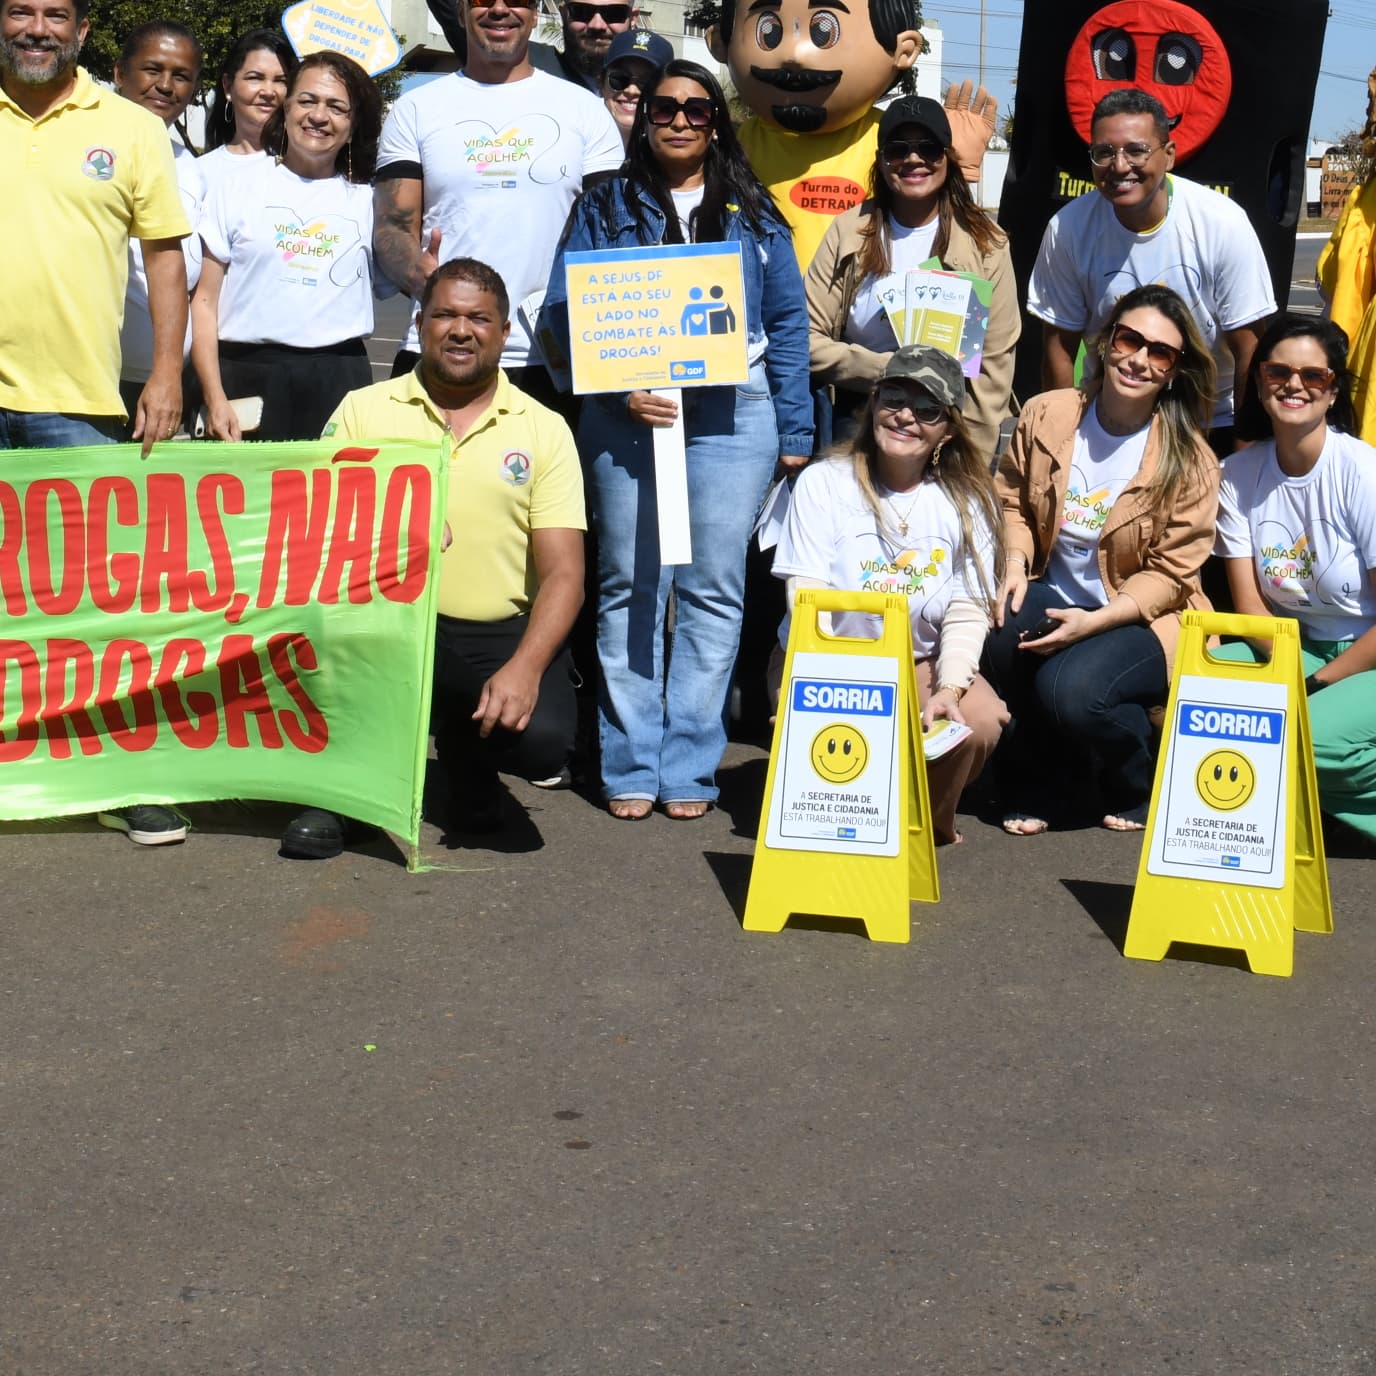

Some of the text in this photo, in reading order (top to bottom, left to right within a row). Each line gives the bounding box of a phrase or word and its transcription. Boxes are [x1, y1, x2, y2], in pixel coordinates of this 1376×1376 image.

[312, 5, 356, 26] LIBERDADE
[314, 20, 357, 41] DEPENDER
[309, 33, 341, 51] DROGAS
[464, 137, 534, 149] VIDAS QUE
[467, 152, 531, 163] ACOLHEM
[800, 181, 859, 196] Turma do
[800, 197, 856, 211] DETRAN
[274, 224, 341, 244] VIDAS QUE
[275, 239, 334, 259] ACOLHEM
[588, 270, 663, 285] A SEJUS-DF
[582, 289, 671, 305] ESTÁ AO SEU
[596, 308, 659, 322] LADO NO
[582, 327, 653, 343] COMBATE
[599, 345, 662, 360] DROGAS!
[256, 446, 432, 609] NÃO
[1261, 546, 1317, 562] VIDAS QUE
[860, 560, 930, 578] VIDAS QUE
[862, 580, 925, 596] ACOLHEM
[802, 685, 884, 712] SORRIA
[1189, 709, 1272, 739] SORRIA
[801, 791, 872, 804] A SECRETARIA DE
[827, 804, 833, 812] E
[834, 805, 879, 815] CIDADANIA
[806, 813, 864, 826] TRABALHANDO
[1184, 817, 1257, 833] A SECRETARIA DE
[1212, 832, 1217, 840] E
[1219, 832, 1265, 845] CIDADANIA
[1189, 839, 1249, 855] TRABALHANDO
